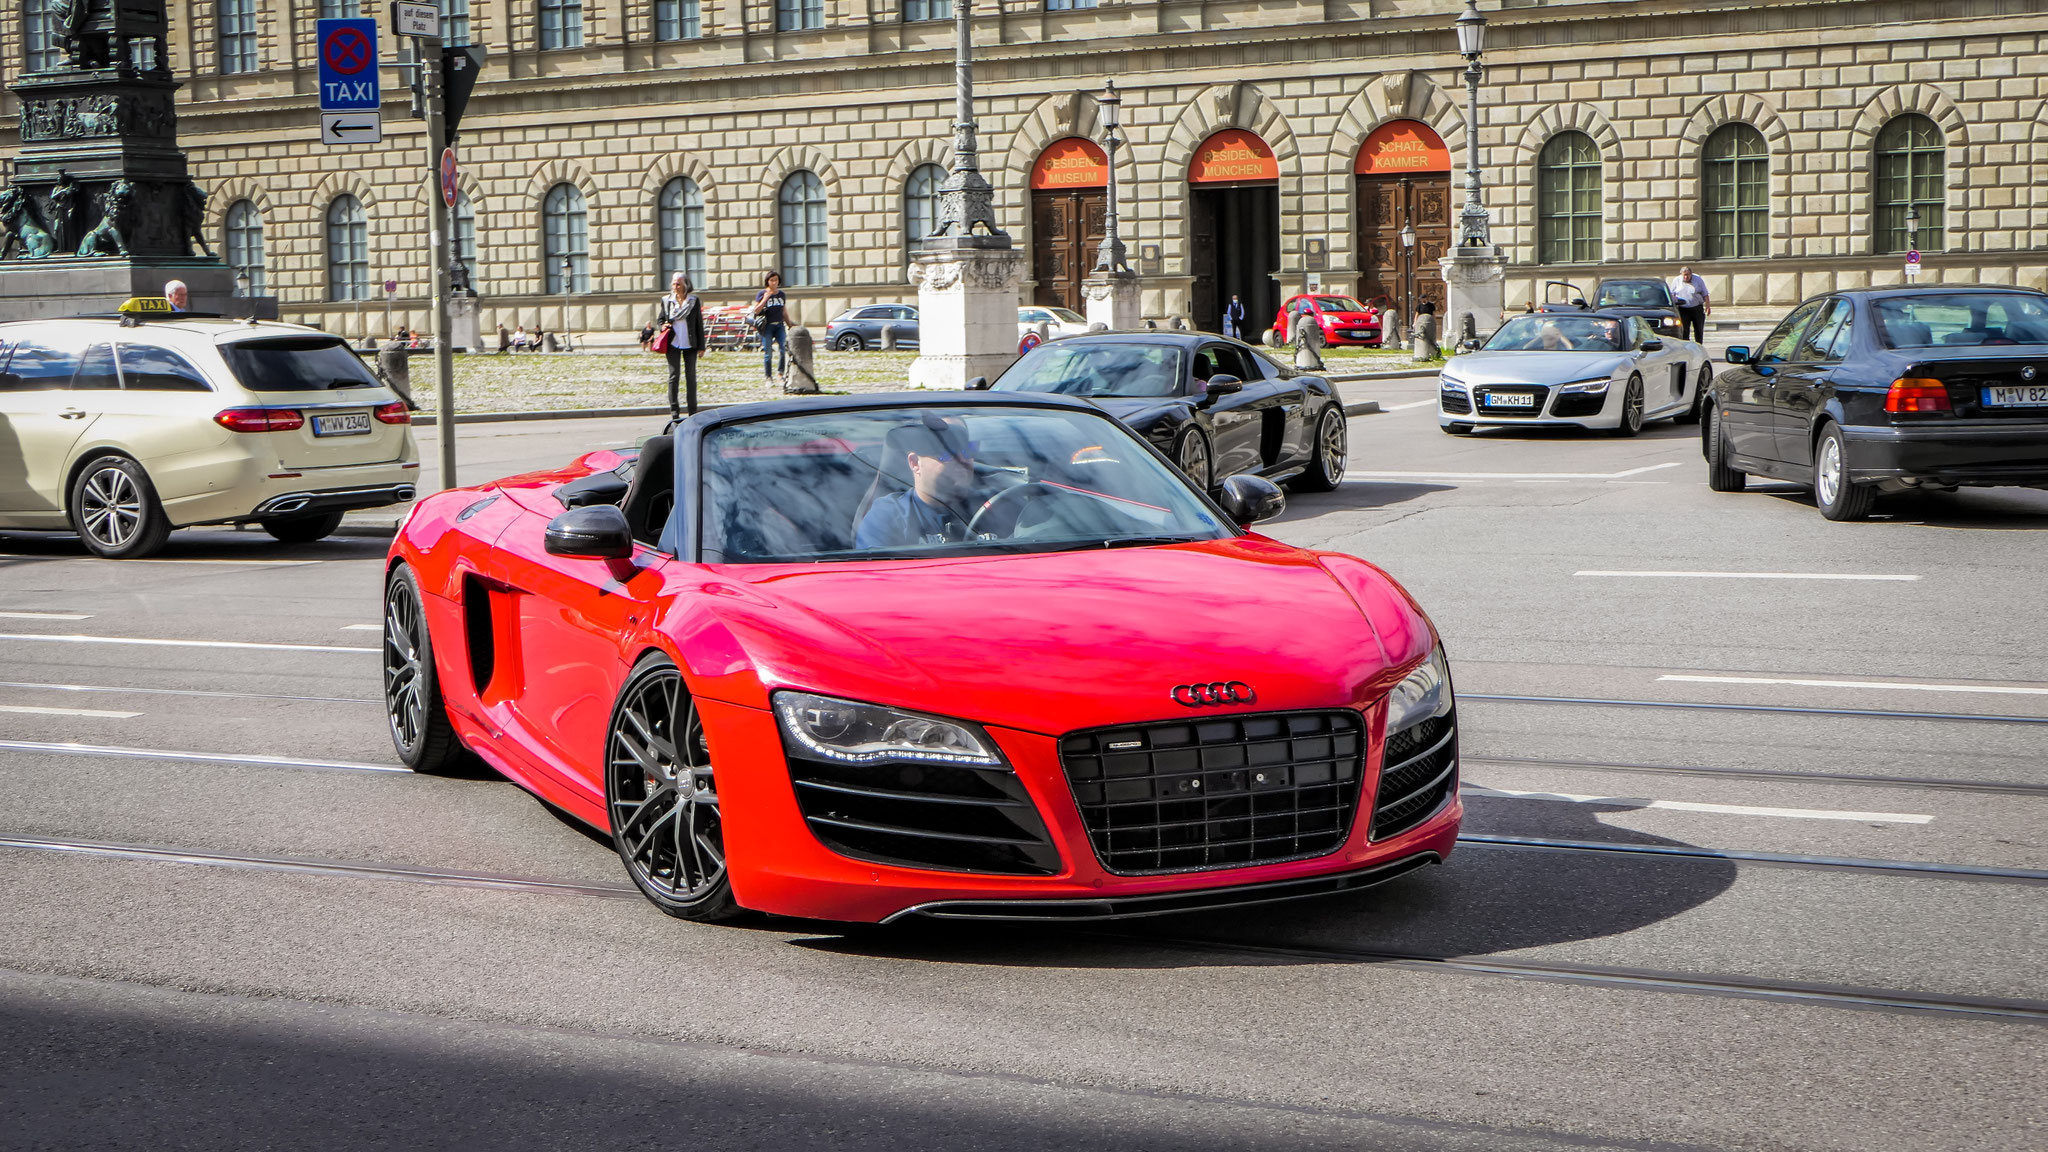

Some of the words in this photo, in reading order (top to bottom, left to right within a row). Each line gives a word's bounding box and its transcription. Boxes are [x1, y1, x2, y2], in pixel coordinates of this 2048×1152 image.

[412, 21, 426, 31] Platz
[325, 82, 374, 102] TAXI
[1378, 140, 1426, 153] SCHATZ
[1203, 149, 1261, 162] RESIDENZ
[1045, 157, 1100, 169] RESIDENZ
[1375, 156, 1429, 168] KAMMER
[1204, 162, 1262, 177] MÜNCHEN
[1048, 172, 1098, 184] MUSEUM
[141, 299, 167, 310] TAXI
[2029, 387, 2048, 402] 82
